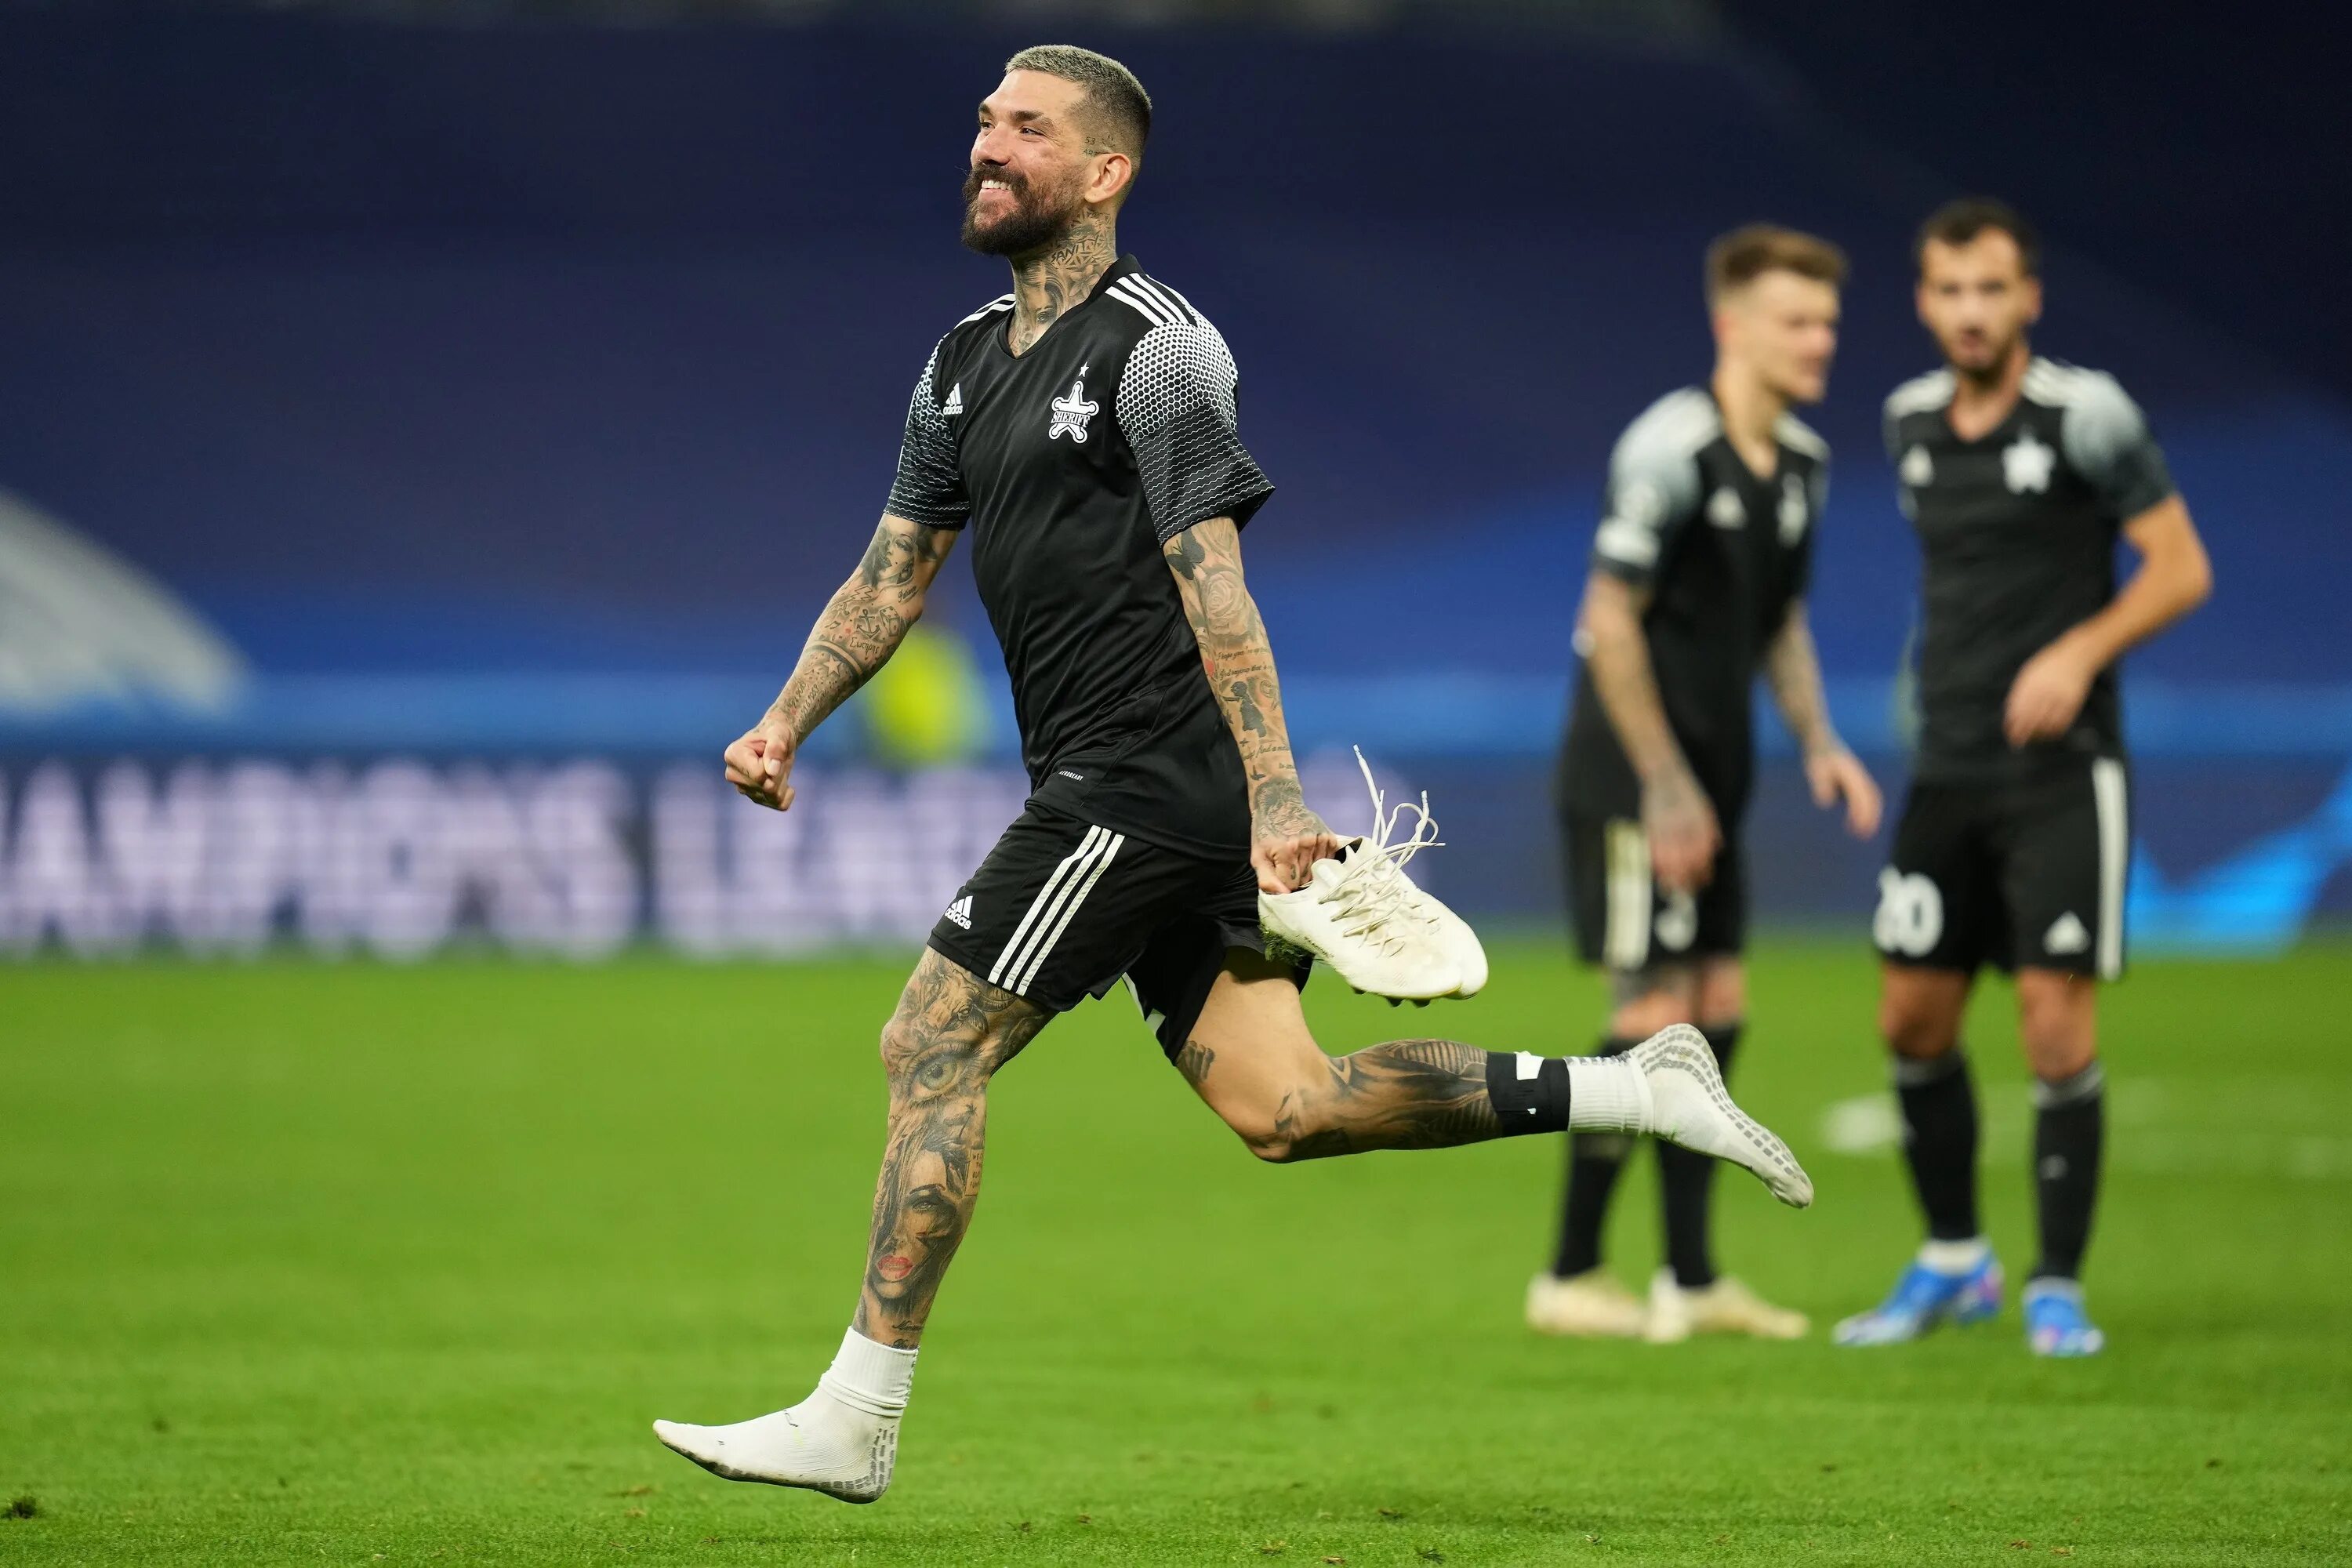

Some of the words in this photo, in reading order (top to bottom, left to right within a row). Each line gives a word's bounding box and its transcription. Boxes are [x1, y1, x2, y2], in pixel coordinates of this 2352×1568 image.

[942, 404, 964, 416] adidas
[1051, 411, 1091, 428] SHERIFF
[0, 753, 639, 960] AMPIONS
[944, 907, 972, 930] adidas
